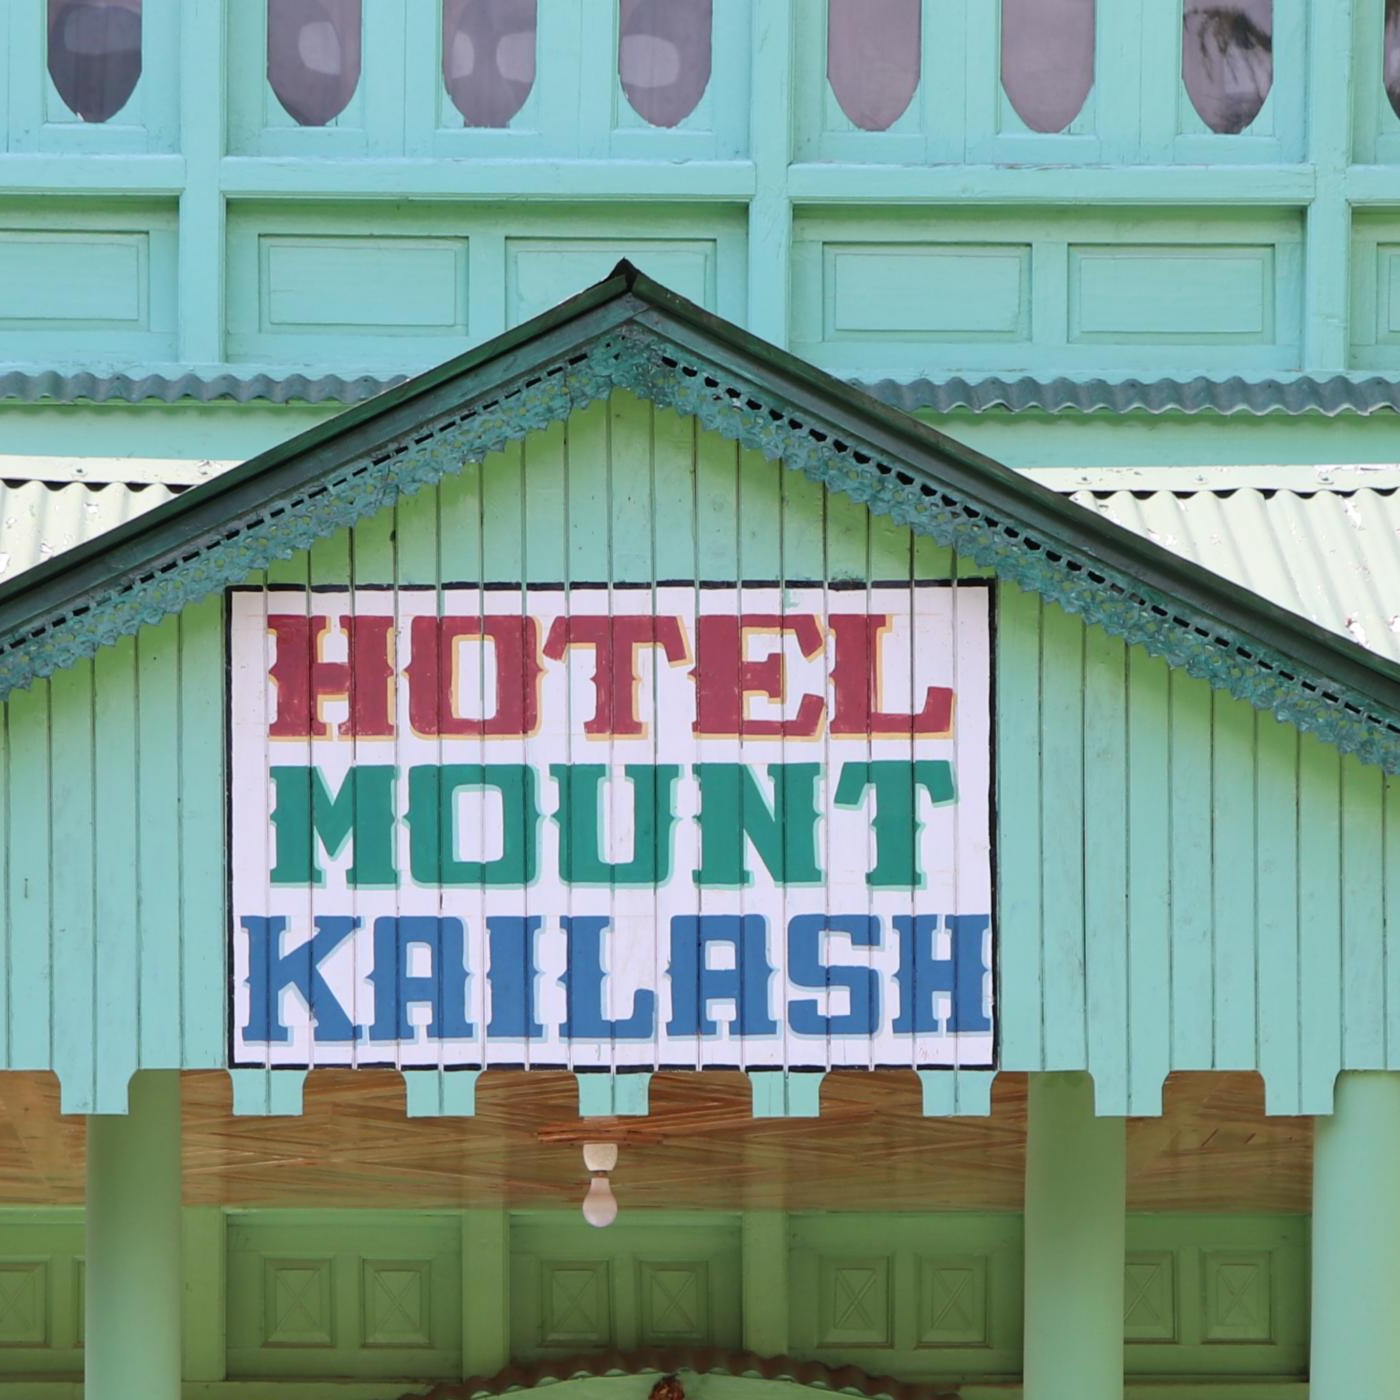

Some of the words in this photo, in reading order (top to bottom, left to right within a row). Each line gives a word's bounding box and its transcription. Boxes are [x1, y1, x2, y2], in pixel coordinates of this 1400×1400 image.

[267, 613, 955, 742] HOTEL
[268, 759, 959, 890] MOUNT
[240, 912, 991, 1044] KAILASH
